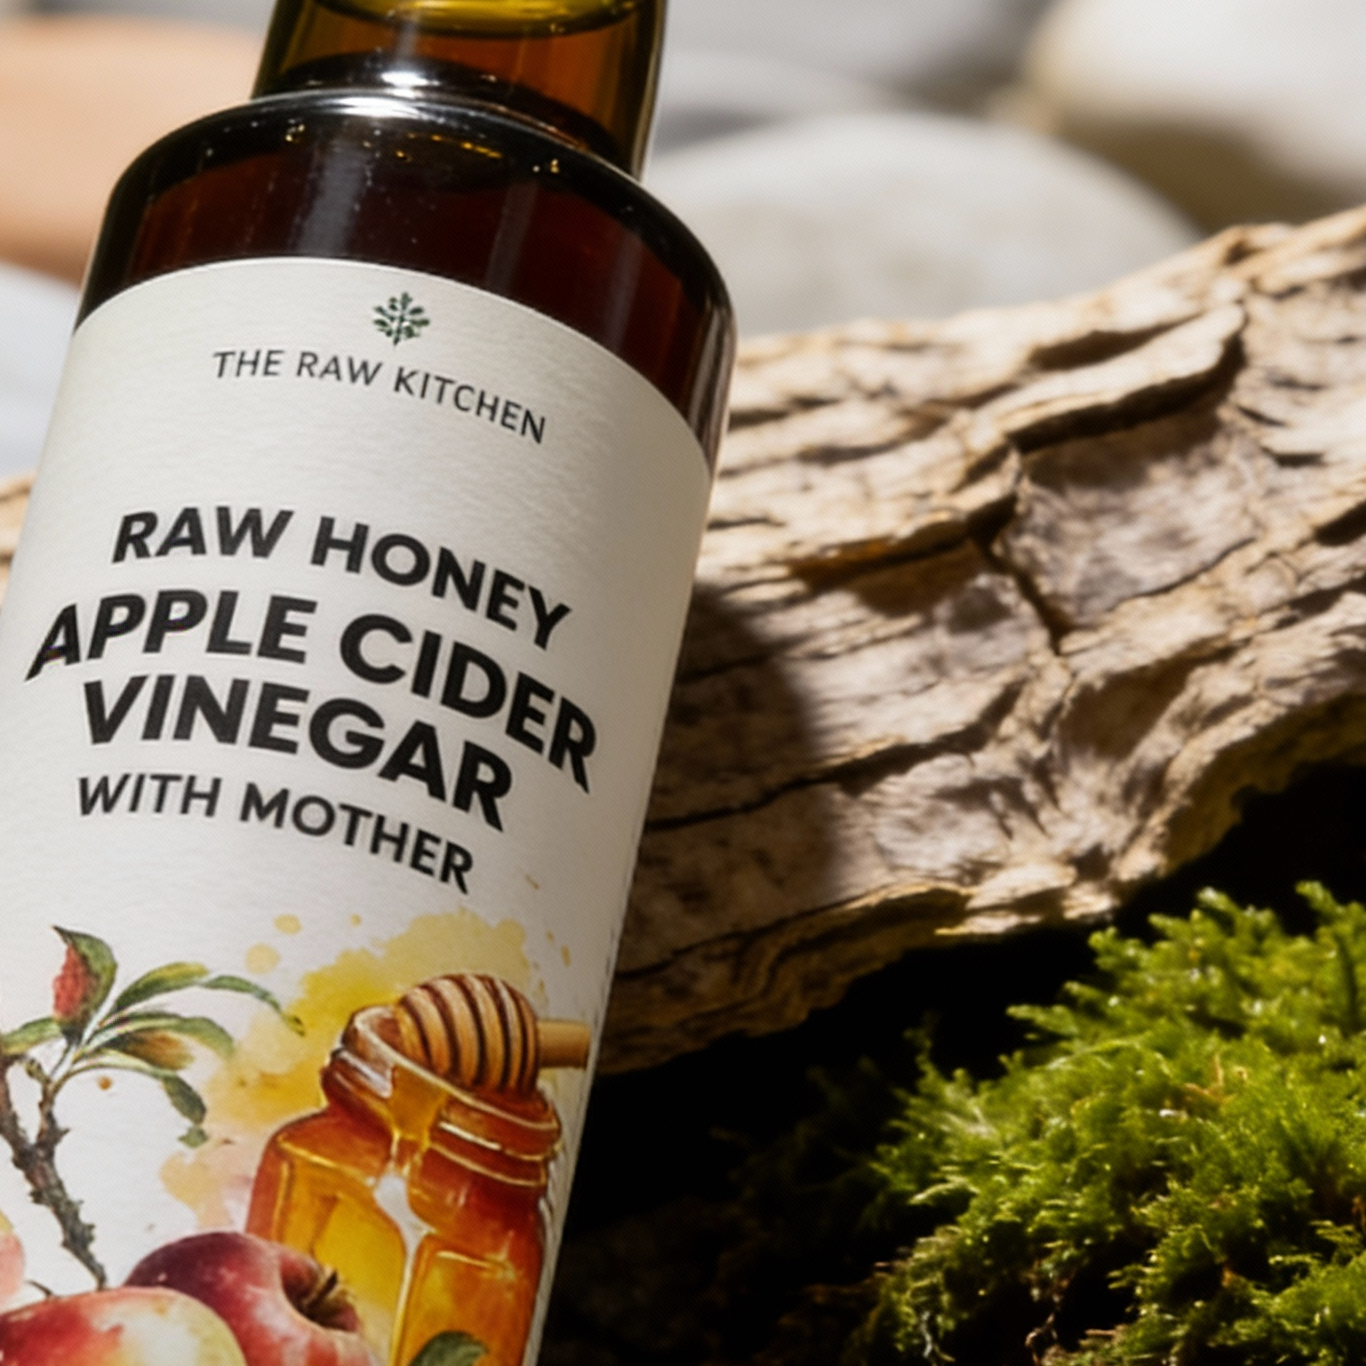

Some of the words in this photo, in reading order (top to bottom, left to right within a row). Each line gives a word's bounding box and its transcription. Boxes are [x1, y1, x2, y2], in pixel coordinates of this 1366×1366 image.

[213, 348, 285, 380] THE
[296, 351, 384, 387] RAW
[393, 366, 546, 444] KITCHEN
[111, 505, 295, 563] RAW
[310, 516, 571, 650] HONEY
[26, 589, 318, 681] APPLE
[339, 613, 597, 794] CIDER
[83, 673, 513, 833] VINEGAR
[78, 773, 223, 817] WITH
[238, 782, 474, 894] MOTHER
